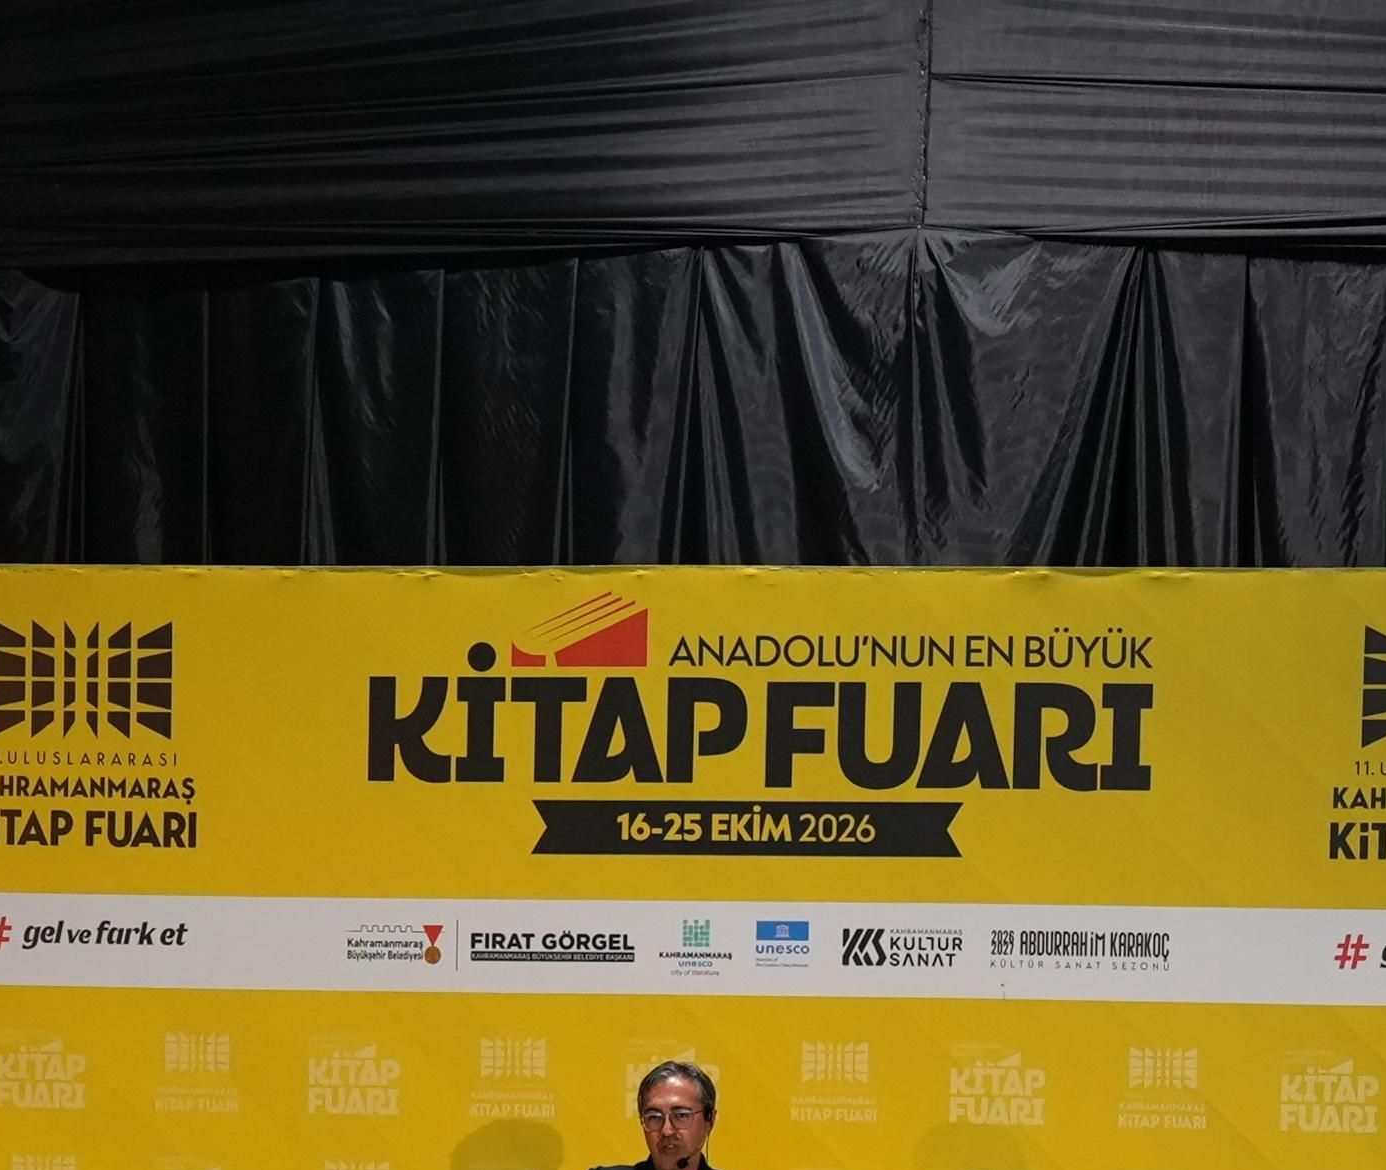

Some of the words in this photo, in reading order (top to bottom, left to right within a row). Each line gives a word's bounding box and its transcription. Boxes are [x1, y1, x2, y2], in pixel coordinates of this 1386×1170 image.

[667, 634, 955, 669] ANADOLU'NUN
[965, 637, 1013, 669] EN
[1024, 627, 1154, 670] BÜYÜK
[367, 642, 749, 784] KİTAP
[765, 681, 1153, 792] FUARI
[85, 810, 197, 848] FUARI
[616, 812, 703, 843] 16-25
[710, 804, 793, 845] EKİM
[797, 813, 877, 845] 2026
[22, 920, 64, 949] gel
[67, 928, 92, 944] ve
[95, 920, 156, 945] fark
[159, 923, 188, 946] et
[347, 938, 424, 950] Kahramanmaraş
[470, 933, 535, 949] FIRAT
[541, 930, 635, 950] GÖRGEL
[1109, 932, 1170, 962] KARAKOÇ
[755, 945, 810, 954] unesco
[1055, 961, 1101, 969] SANAT
[308, 1087, 400, 1115] FUARI
[949, 1096, 1045, 1125] FUARI
[1279, 1104, 1378, 1133] FUARI
